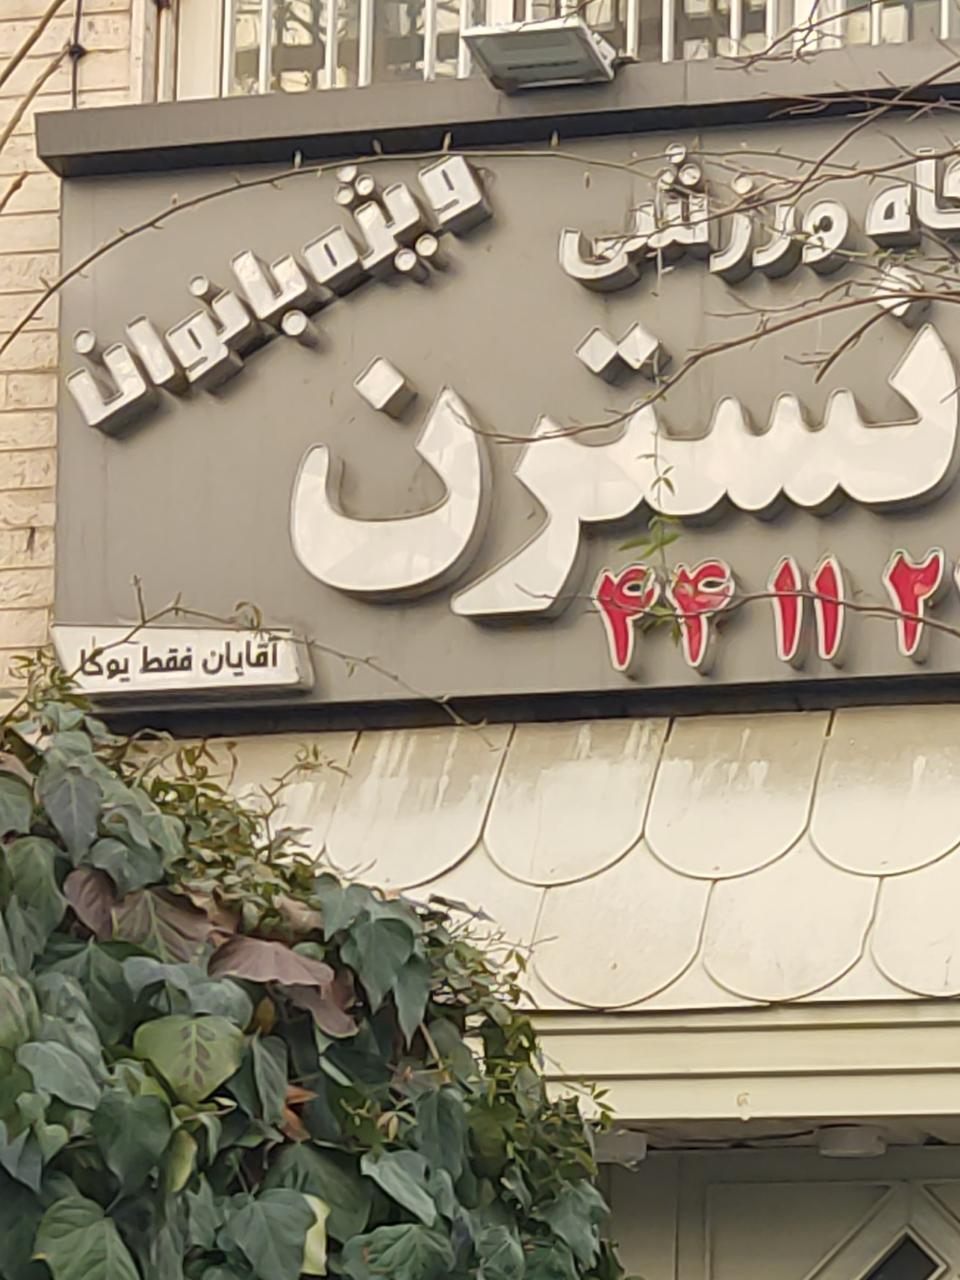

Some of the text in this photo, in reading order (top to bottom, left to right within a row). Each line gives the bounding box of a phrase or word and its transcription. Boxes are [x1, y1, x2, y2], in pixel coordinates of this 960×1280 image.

[558, 143, 850, 282] ورزشی
[65, 154, 485, 428] ویژه بانوان
[290, 264, 960, 616] نسترن
[139, 645, 193, 675] فقط
[201, 636, 278, 677] آقایان
